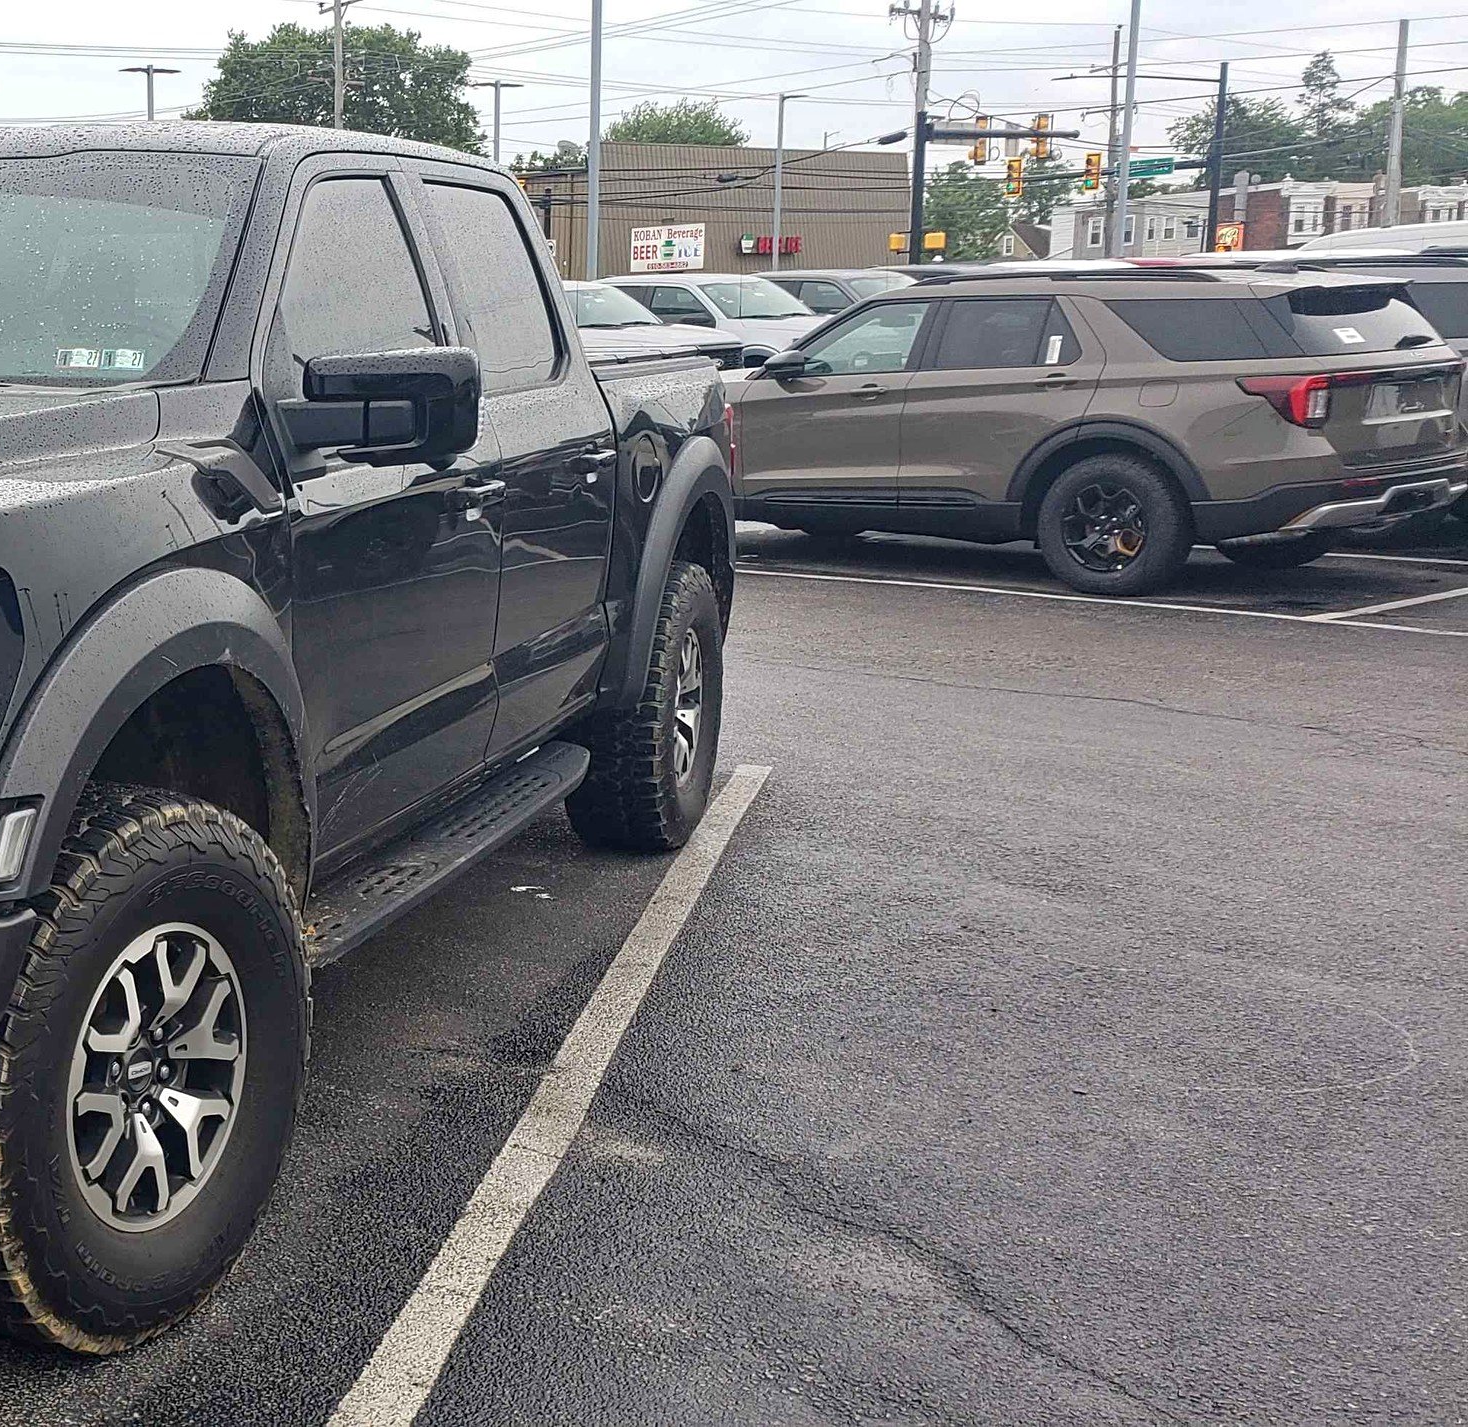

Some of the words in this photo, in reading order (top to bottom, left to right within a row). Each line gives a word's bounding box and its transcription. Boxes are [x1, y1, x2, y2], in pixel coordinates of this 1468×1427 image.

[633, 228, 663, 242] KOBAN
[667, 227, 703, 242] Beverage
[633, 244, 658, 260] BEER
[678, 243, 702, 258] ICE
[86, 351, 98, 366] 27
[131, 352, 143, 367] 27
